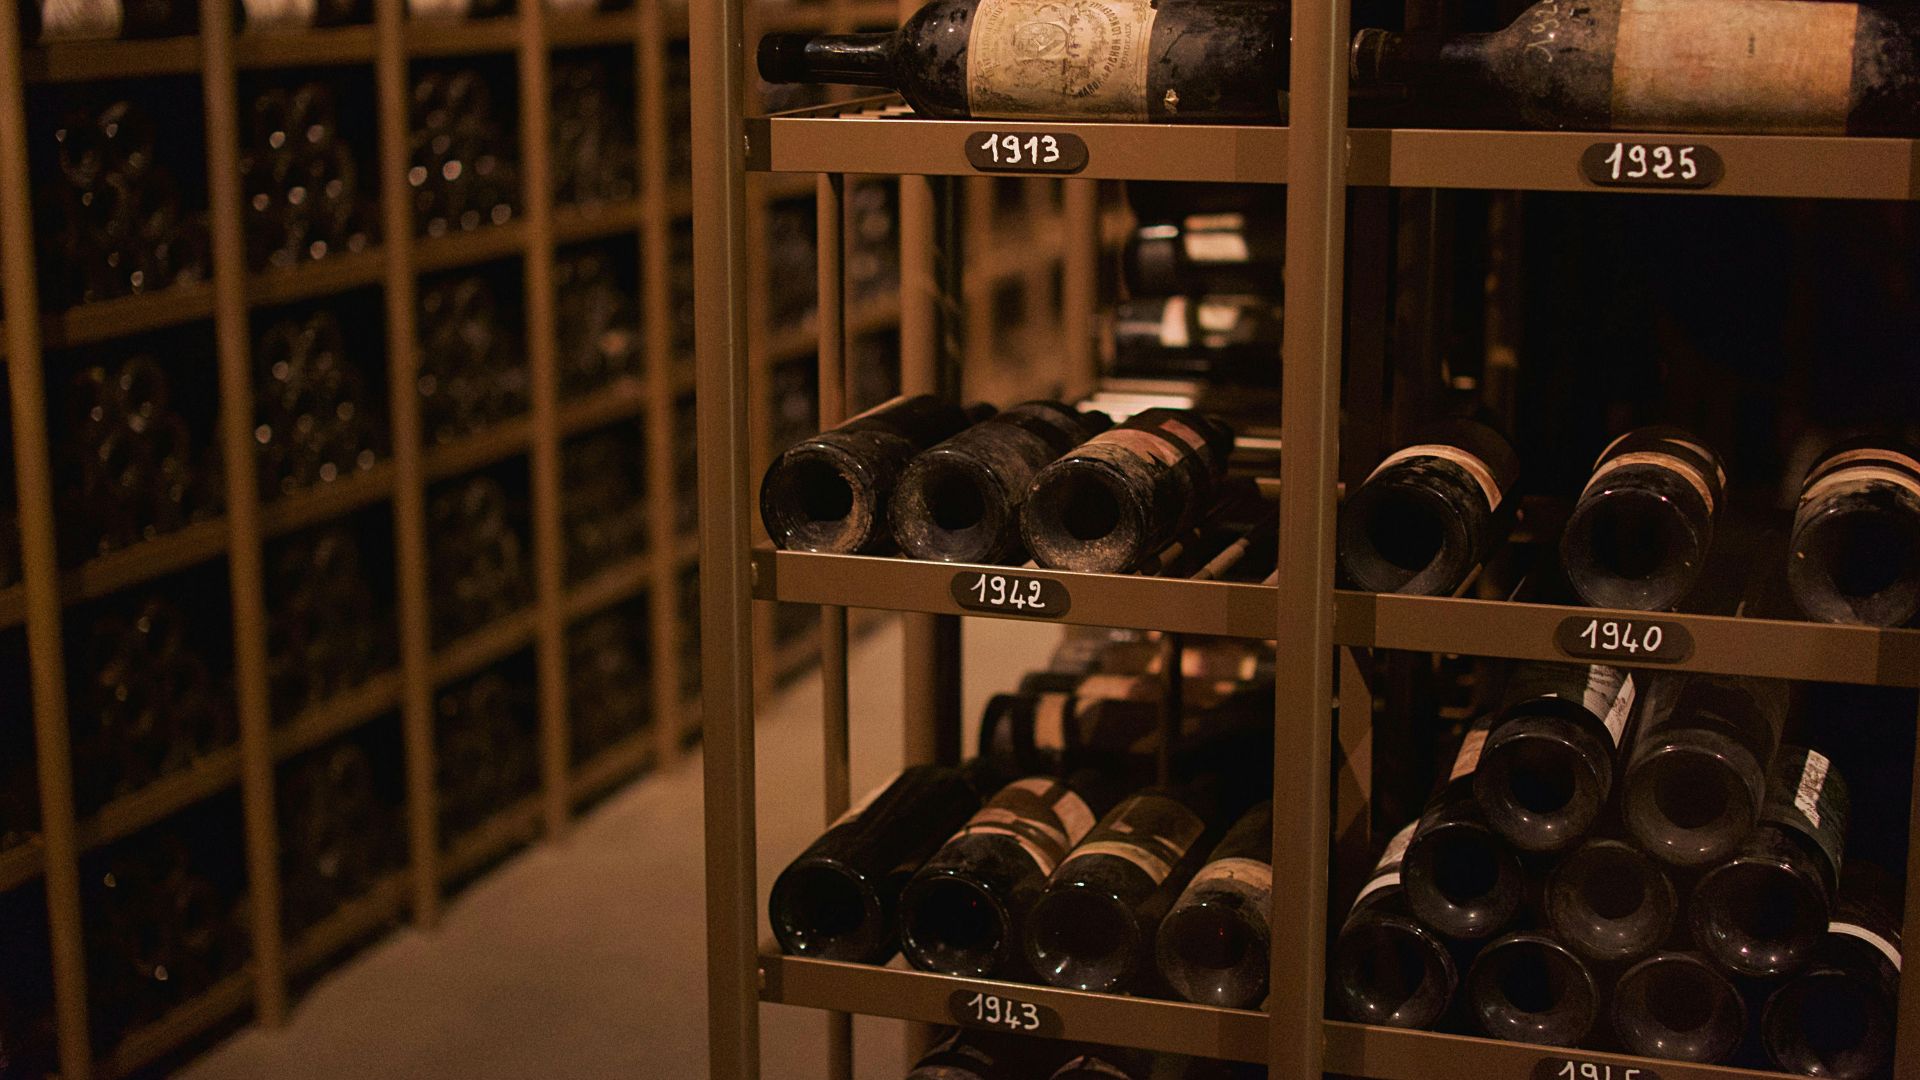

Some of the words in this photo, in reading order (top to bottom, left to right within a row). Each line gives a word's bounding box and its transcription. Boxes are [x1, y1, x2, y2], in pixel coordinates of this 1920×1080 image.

[981, 133, 1060, 165] 1913
[1604, 142, 1697, 180] 1925
[970, 573, 1046, 609] 1942
[1580, 619, 1663, 653] 1940
[967, 993, 1041, 1031] 1943
